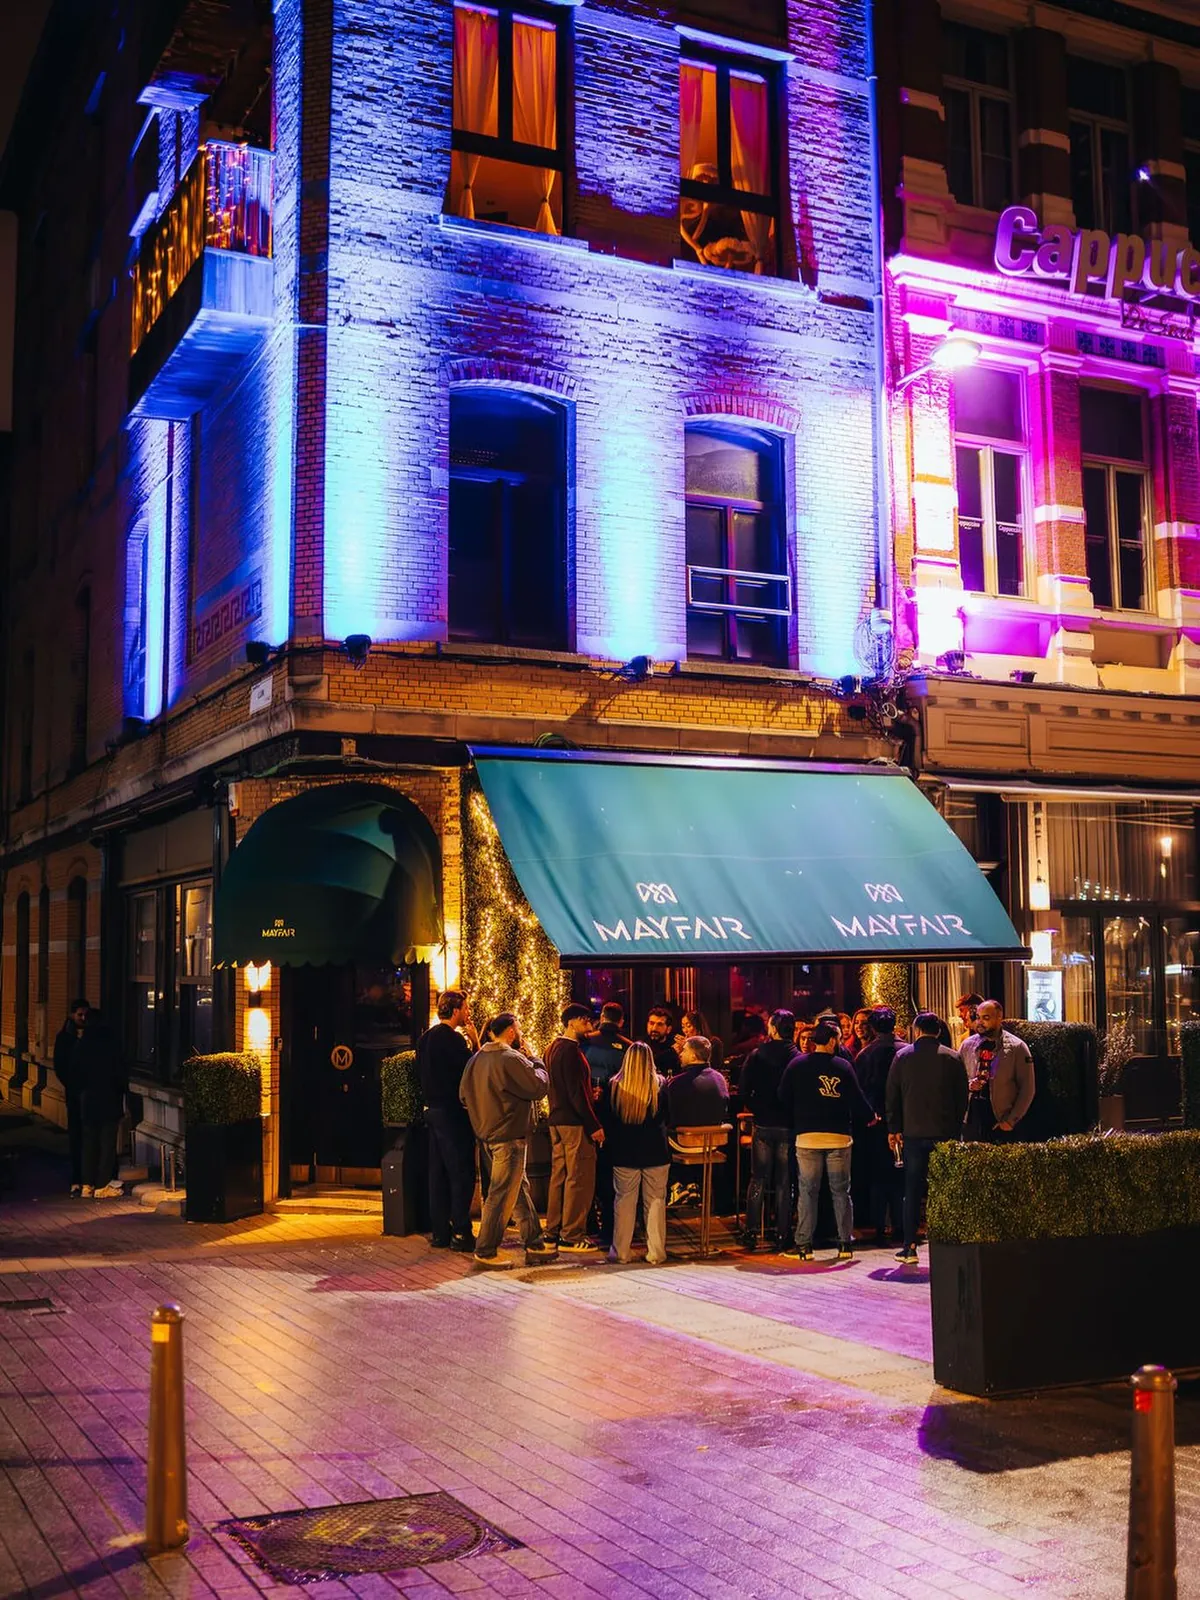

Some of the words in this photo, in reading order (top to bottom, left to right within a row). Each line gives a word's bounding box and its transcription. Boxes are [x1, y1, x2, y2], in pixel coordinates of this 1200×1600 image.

[262, 928, 295, 937] MAYFAIR
[592, 916, 752, 941] MAYFAIR
[830, 914, 972, 937] MAYFAIR
